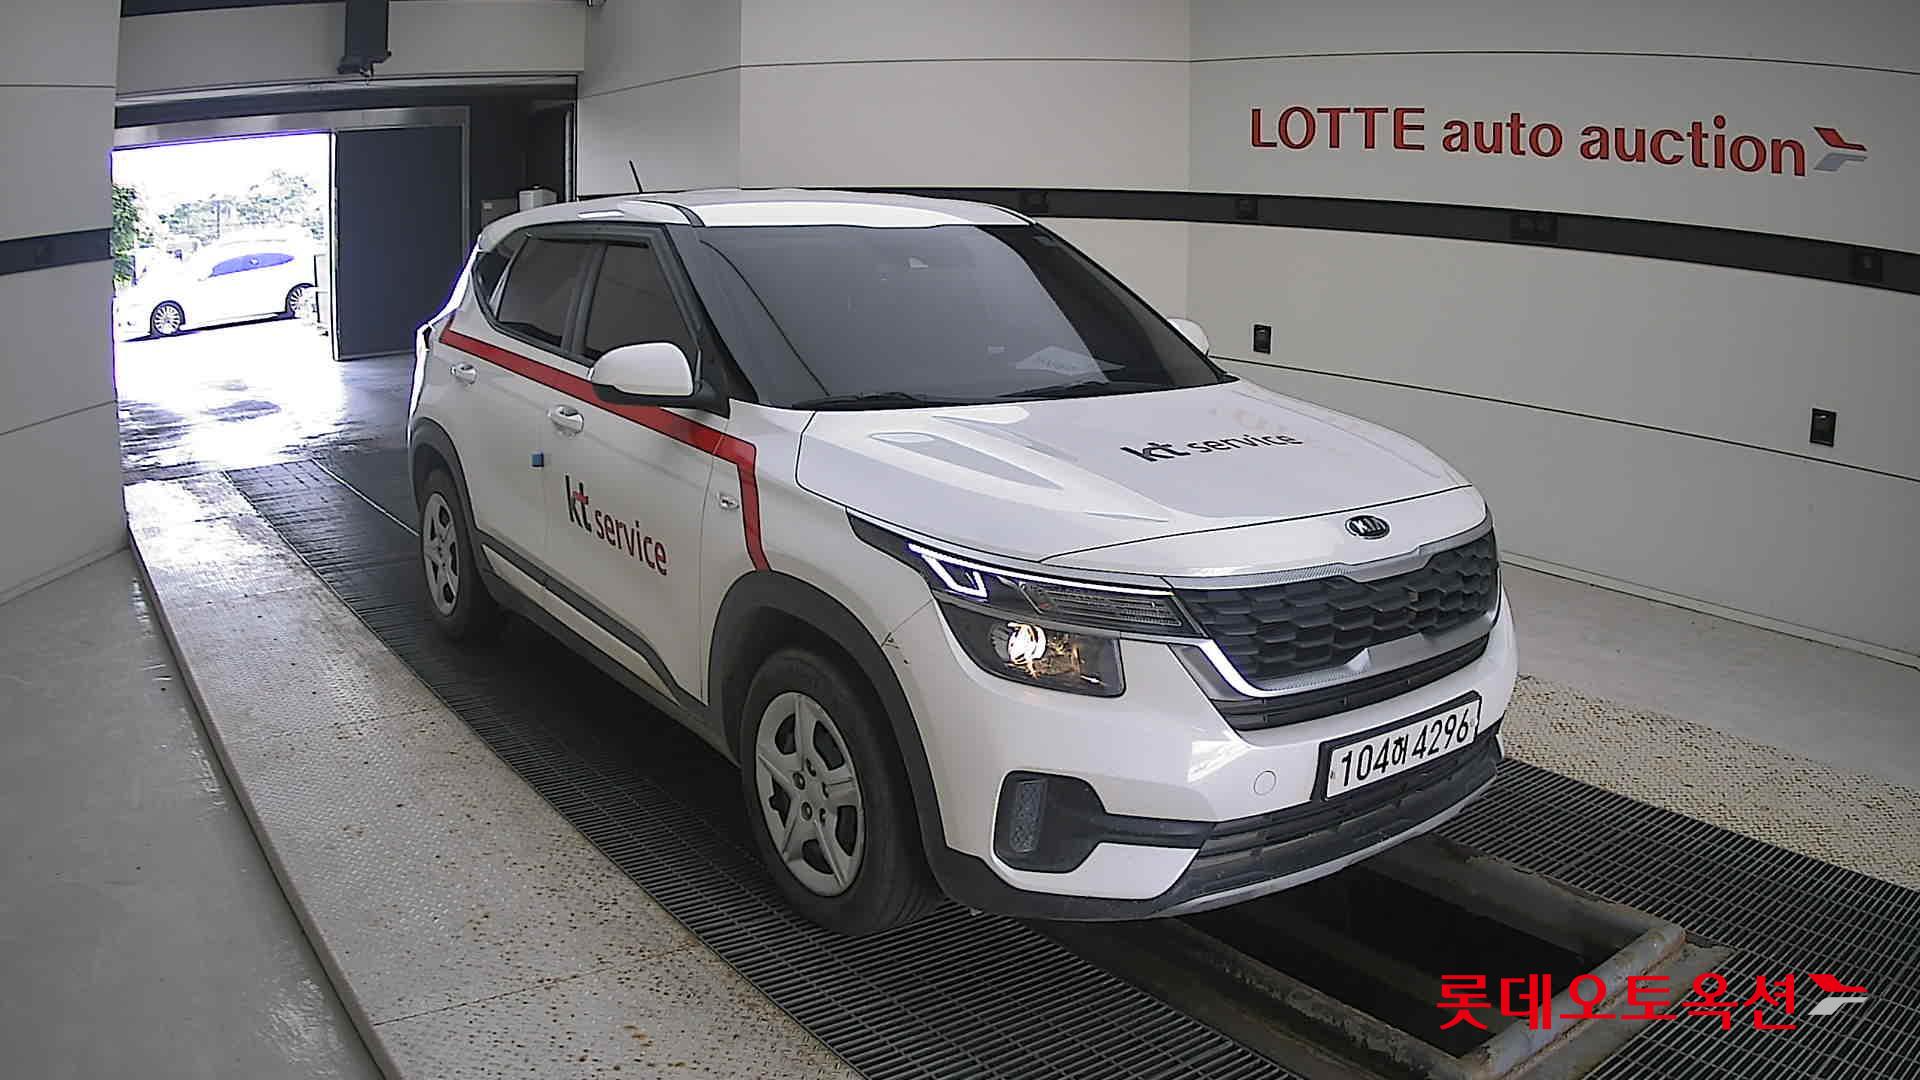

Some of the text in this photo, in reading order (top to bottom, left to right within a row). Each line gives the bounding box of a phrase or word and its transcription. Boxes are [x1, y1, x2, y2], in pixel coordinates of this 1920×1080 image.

[1250, 106, 1806, 177] LOTTE auto auction
[1120, 434, 1304, 462] kt service
[565, 475, 667, 576] kt service
